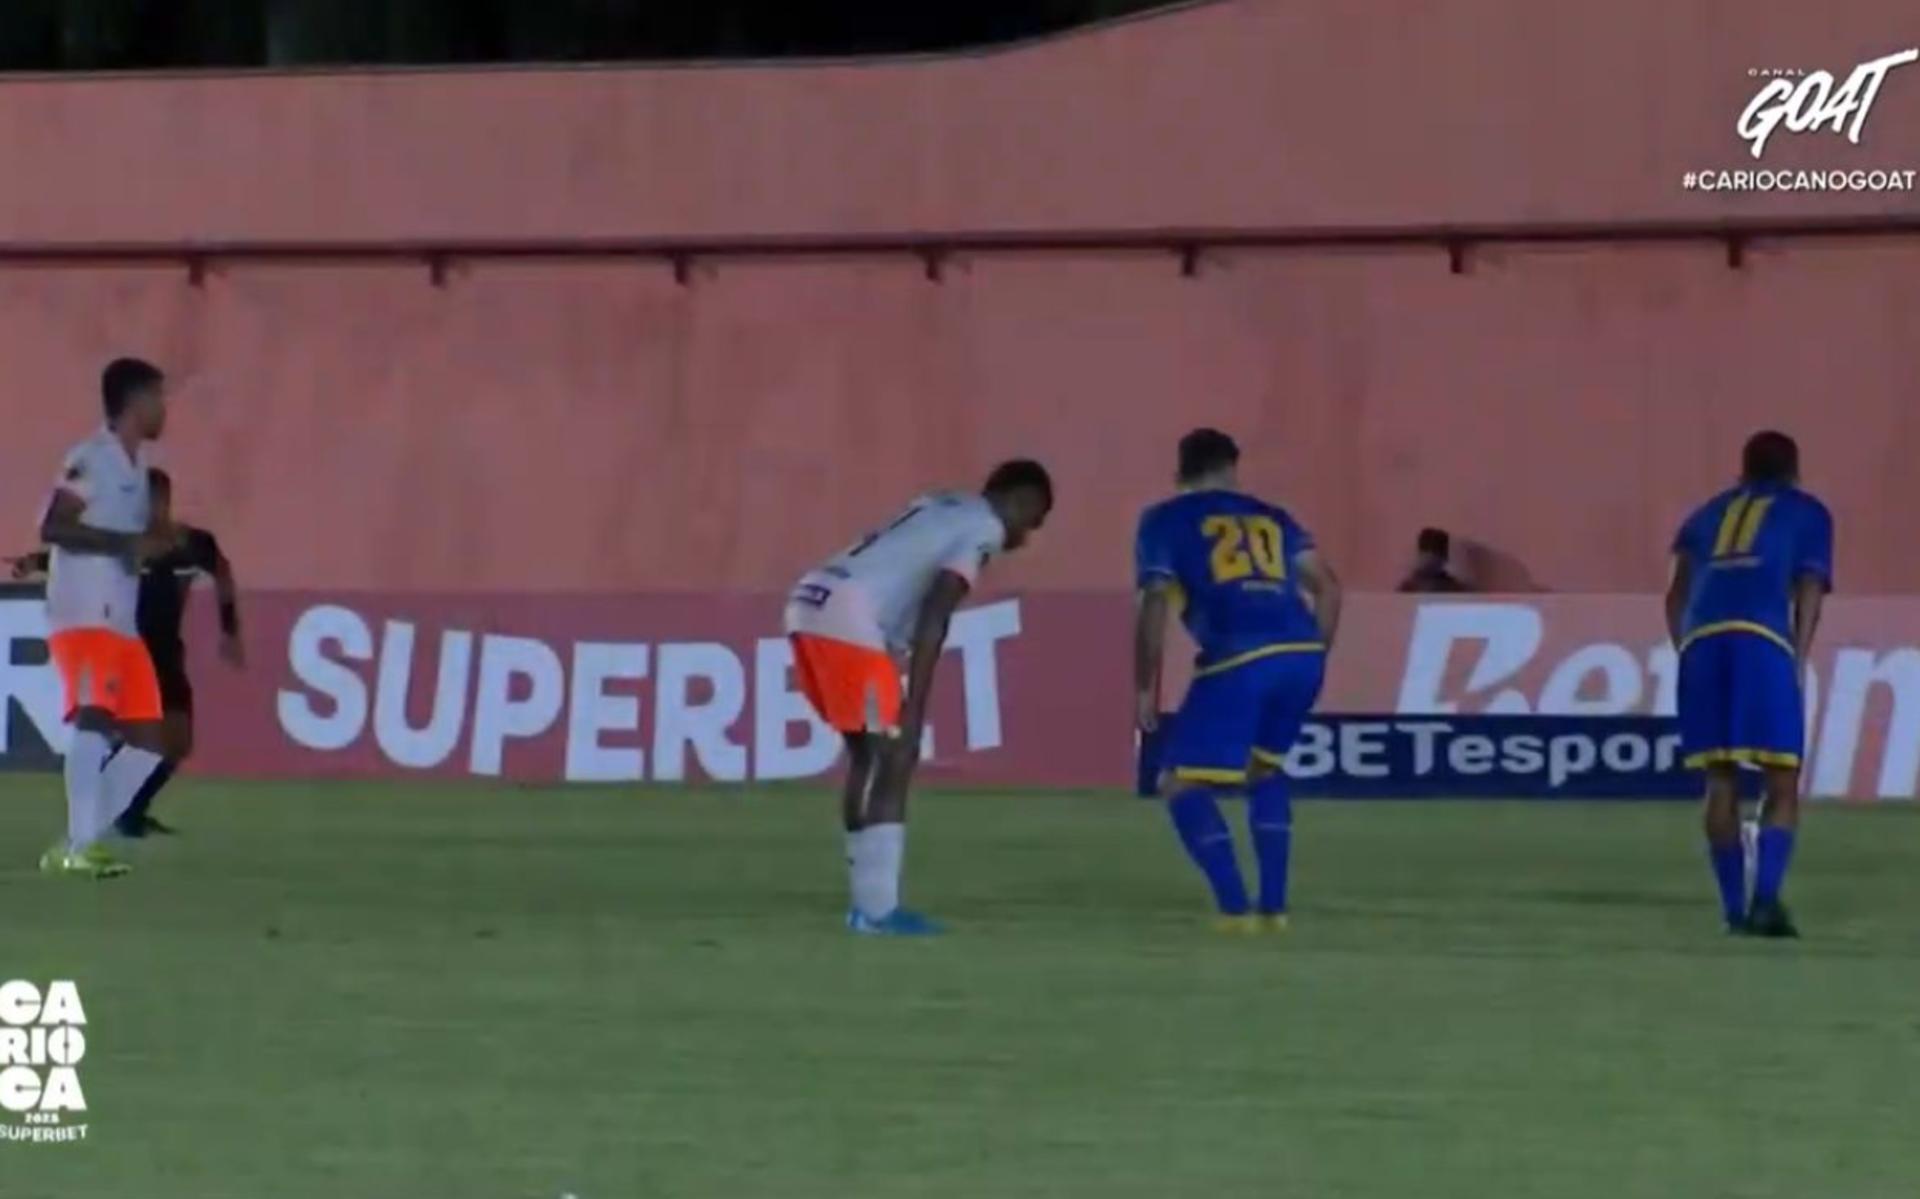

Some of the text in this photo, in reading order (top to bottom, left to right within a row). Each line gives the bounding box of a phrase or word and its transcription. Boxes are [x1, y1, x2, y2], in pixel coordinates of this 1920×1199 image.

[1202, 515, 1284, 582] 20
[1713, 495, 1774, 555] 11
[277, 598, 1021, 782] SUPERBT
[1282, 722, 1760, 788] BETespor
